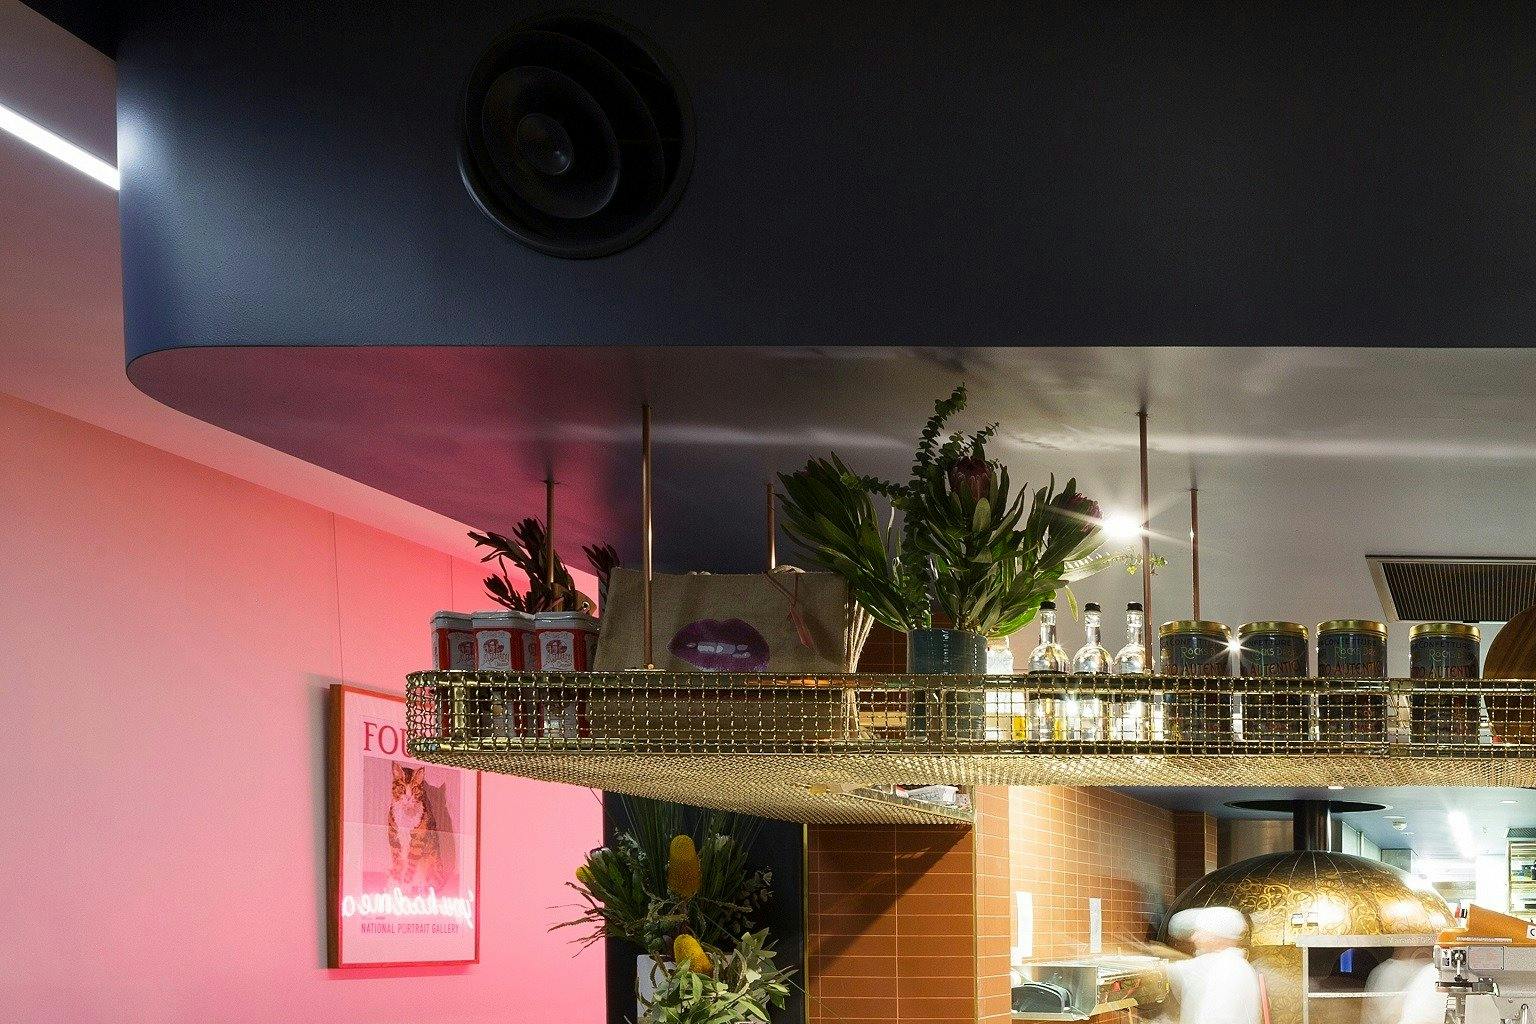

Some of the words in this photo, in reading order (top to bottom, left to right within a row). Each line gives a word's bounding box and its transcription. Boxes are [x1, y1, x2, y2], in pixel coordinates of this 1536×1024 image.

[361, 922, 395, 934] NATIONAL
[397, 923, 430, 934] PORTRAIT
[431, 923, 459, 934] GALLERY
